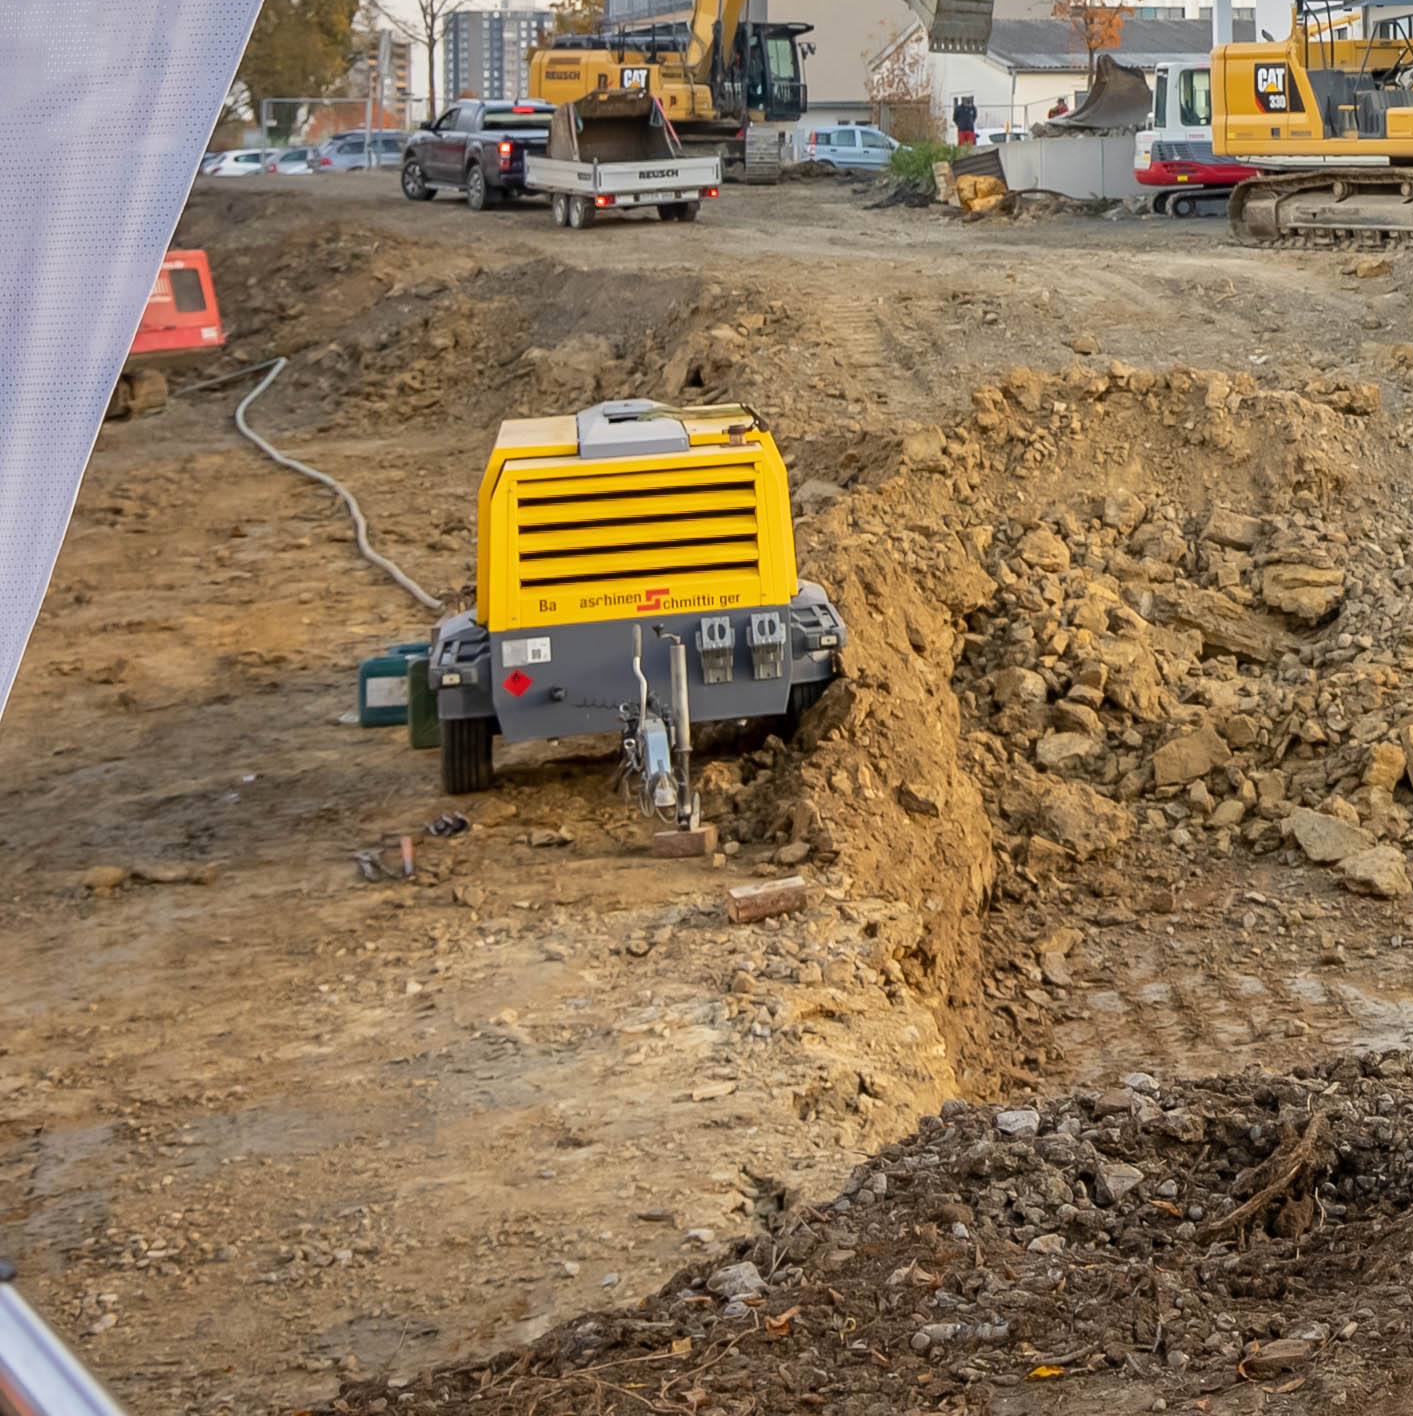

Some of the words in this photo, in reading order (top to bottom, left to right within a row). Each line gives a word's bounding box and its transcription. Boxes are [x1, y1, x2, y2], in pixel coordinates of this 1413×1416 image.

[623, 69, 649, 89] CAT
[1257, 68, 1286, 93] CAT
[1268, 94, 1287, 110] 330
[638, 169, 679, 180] REUSCH
